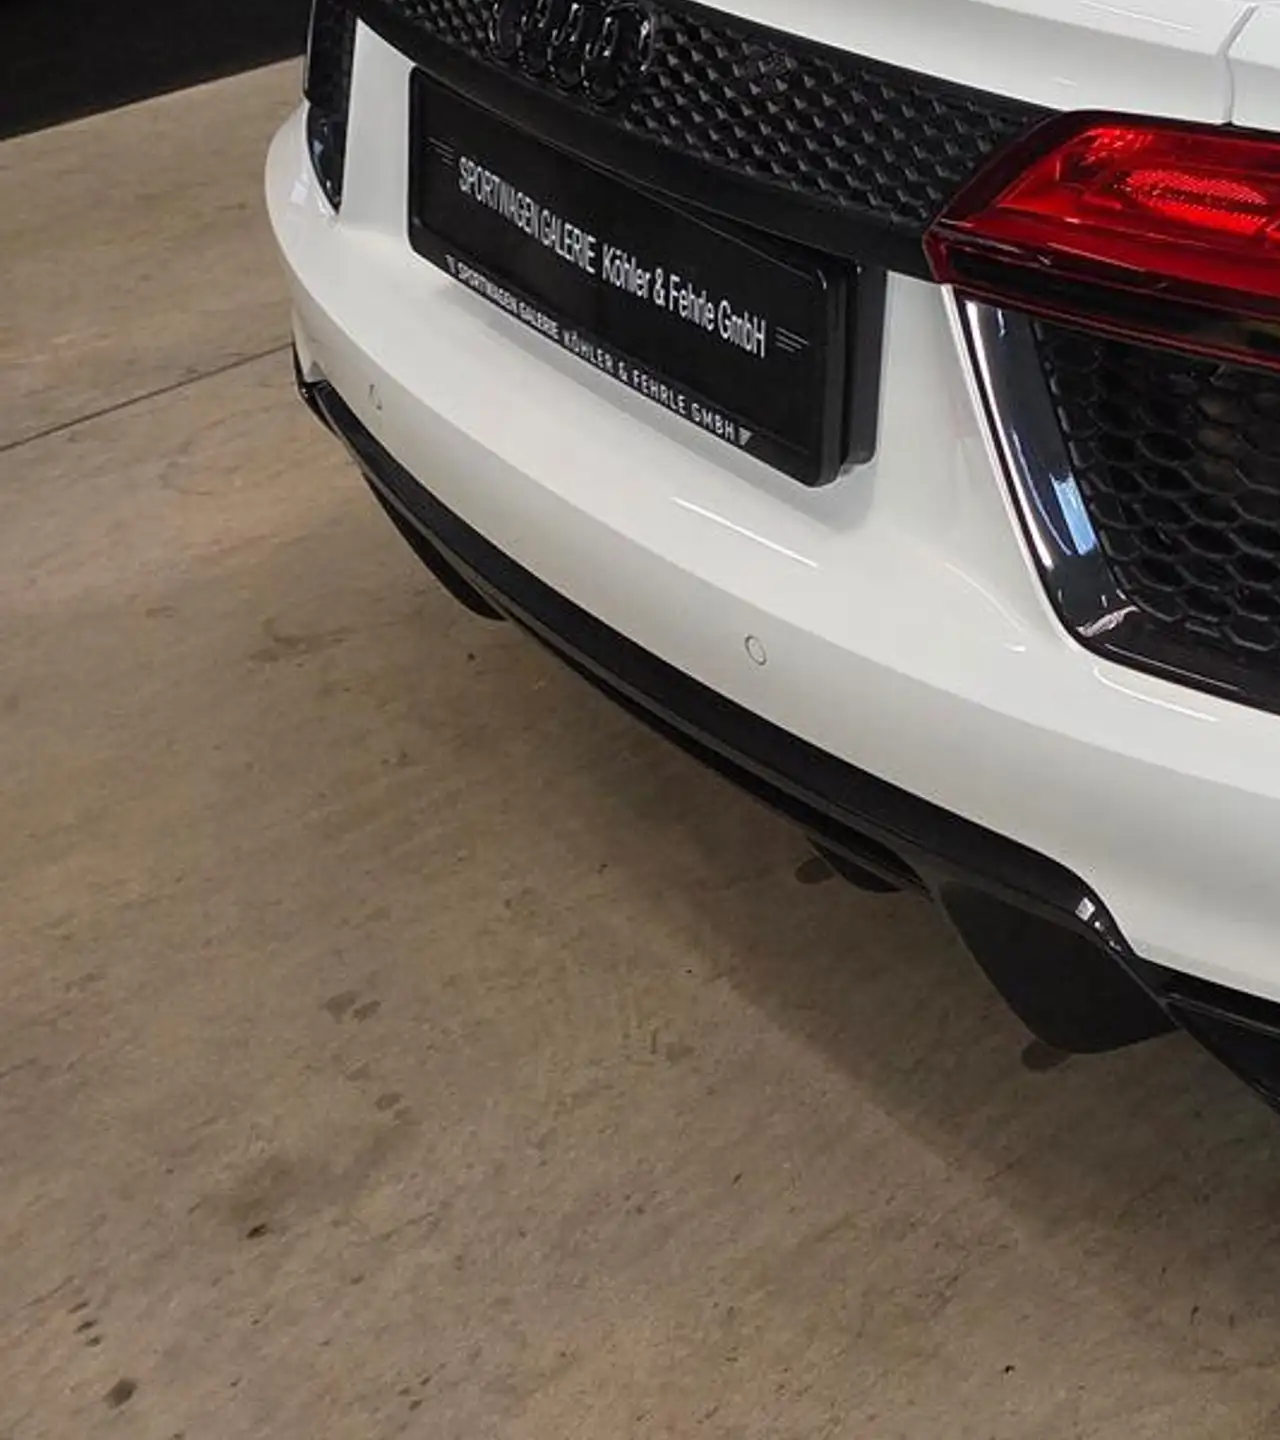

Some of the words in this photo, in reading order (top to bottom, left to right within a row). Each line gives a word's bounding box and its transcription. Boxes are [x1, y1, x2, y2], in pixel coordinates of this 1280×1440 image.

[458, 155, 540, 239] SPORTWAGEN
[540, 208, 597, 275] GALERIE
[602, 243, 650, 300] Köhler
[653, 267, 666, 307] &
[669, 273, 715, 332] Fehrle
[717, 299, 766, 359] GmbH
[561, 328, 614, 373] KÖHLER
[618, 361, 629, 382] &
[632, 369, 687, 415] FEHRLE
[690, 402, 736, 442] GMBH
